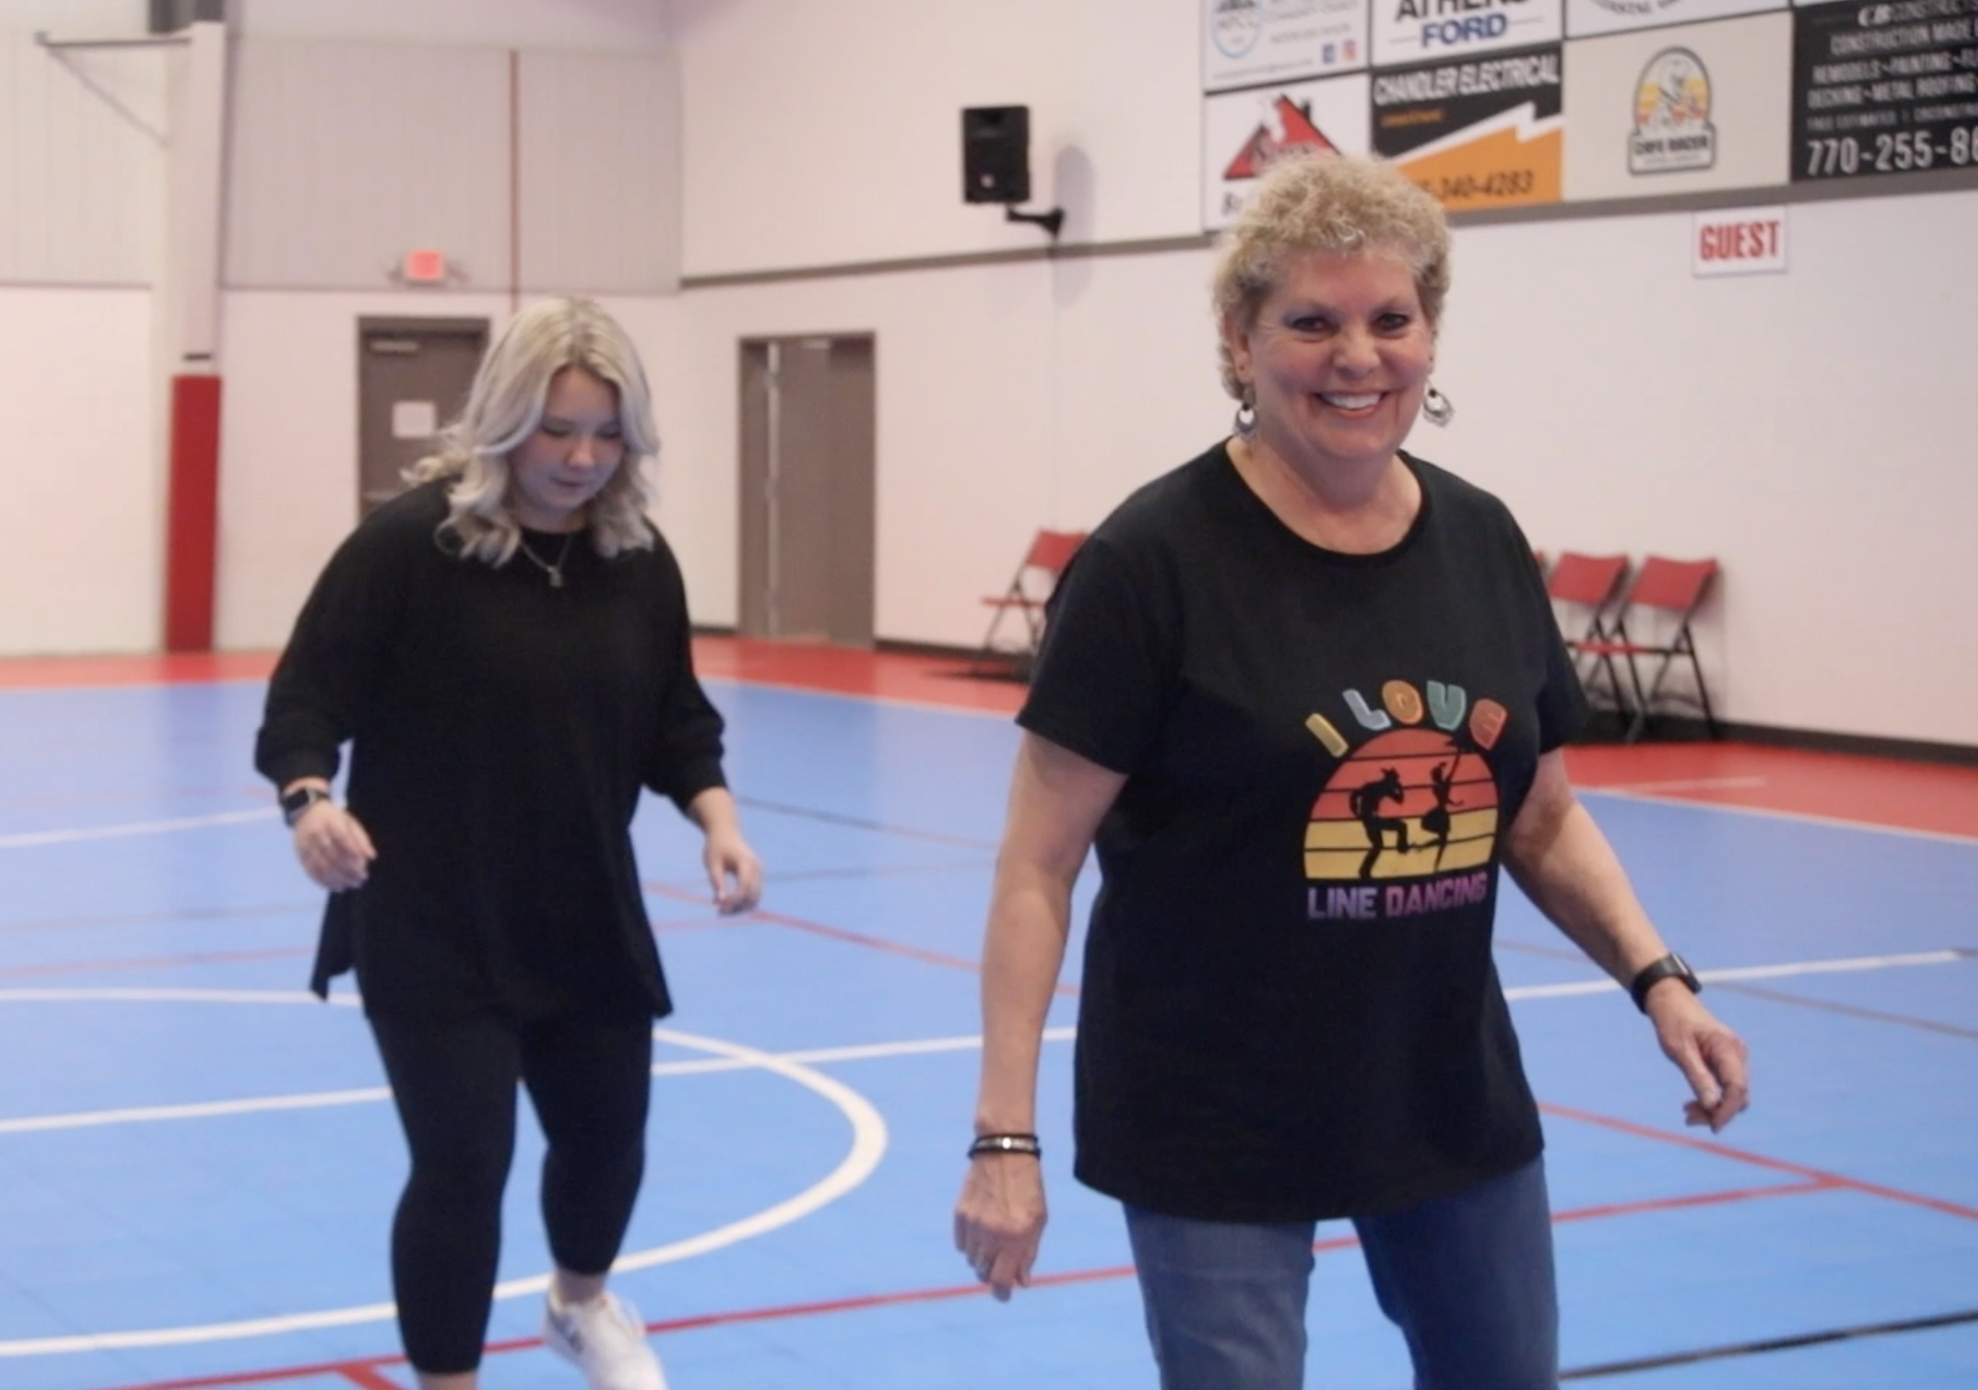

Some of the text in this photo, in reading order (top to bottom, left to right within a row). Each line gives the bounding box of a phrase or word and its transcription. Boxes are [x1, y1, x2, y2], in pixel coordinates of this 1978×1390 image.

[1421, 12, 1508, 48] FORD
[1373, 54, 1560, 106] CHANDLER ELECTRICAL
[1699, 220, 1780, 262] GUEST
[1305, 679, 1508, 758] I LOVE
[1307, 871, 1488, 919] LINE DANCING
